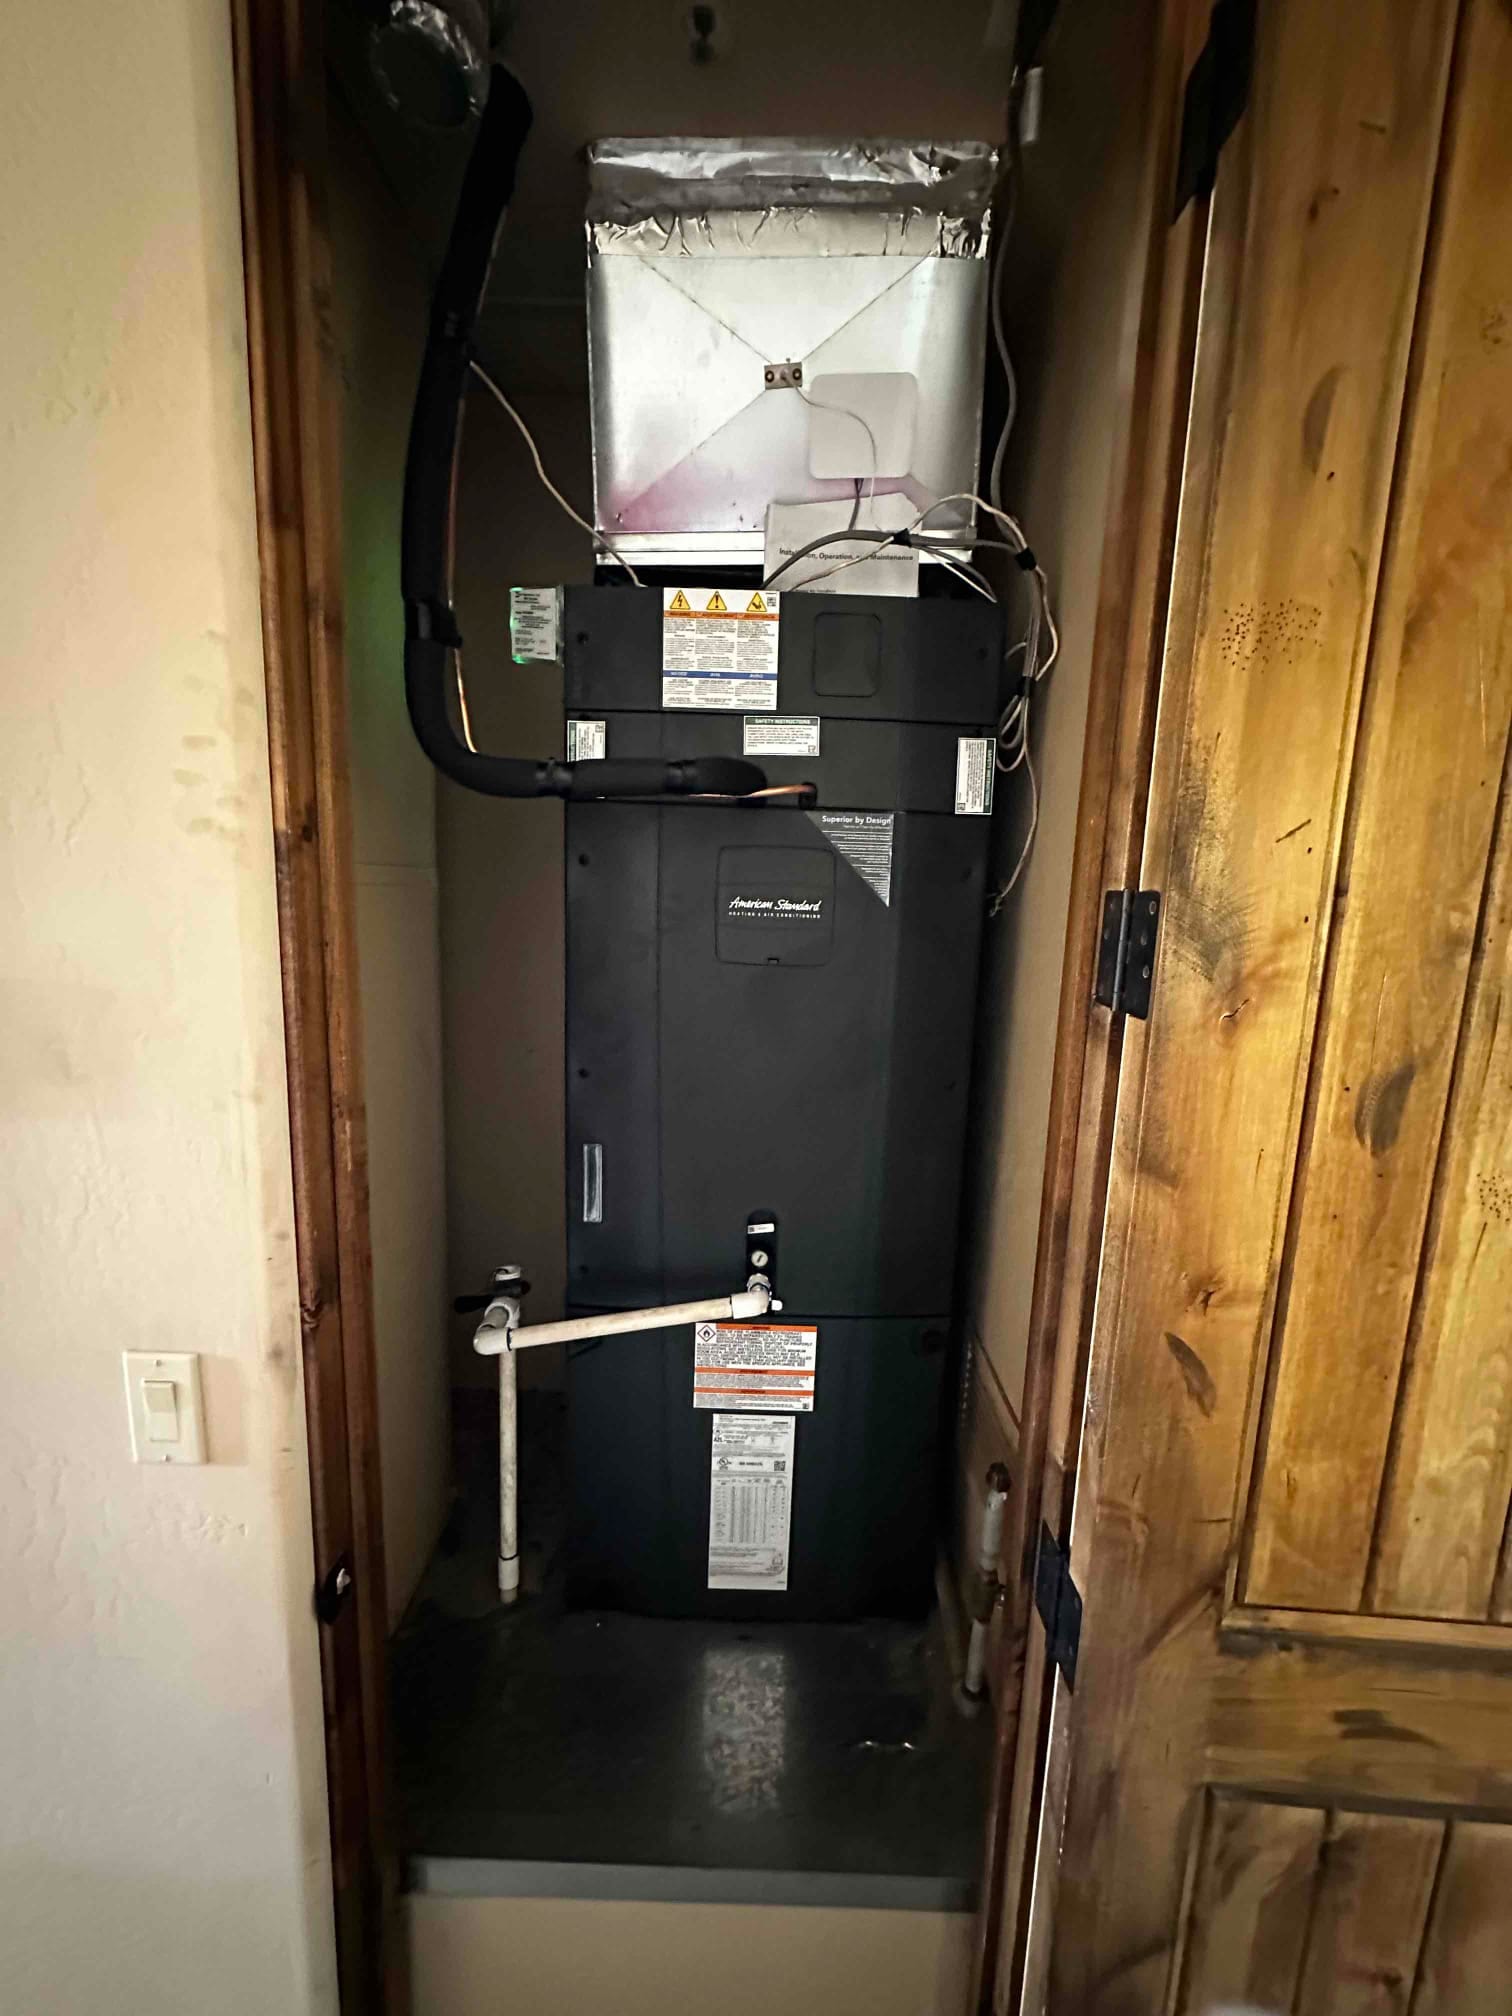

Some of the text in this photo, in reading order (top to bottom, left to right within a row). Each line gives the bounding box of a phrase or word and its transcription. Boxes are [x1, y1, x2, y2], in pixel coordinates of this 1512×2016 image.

[819, 553, 853, 561] Operation,
[822, 815, 891, 825] Superior by Design
[728, 896, 822, 911] American Standard
